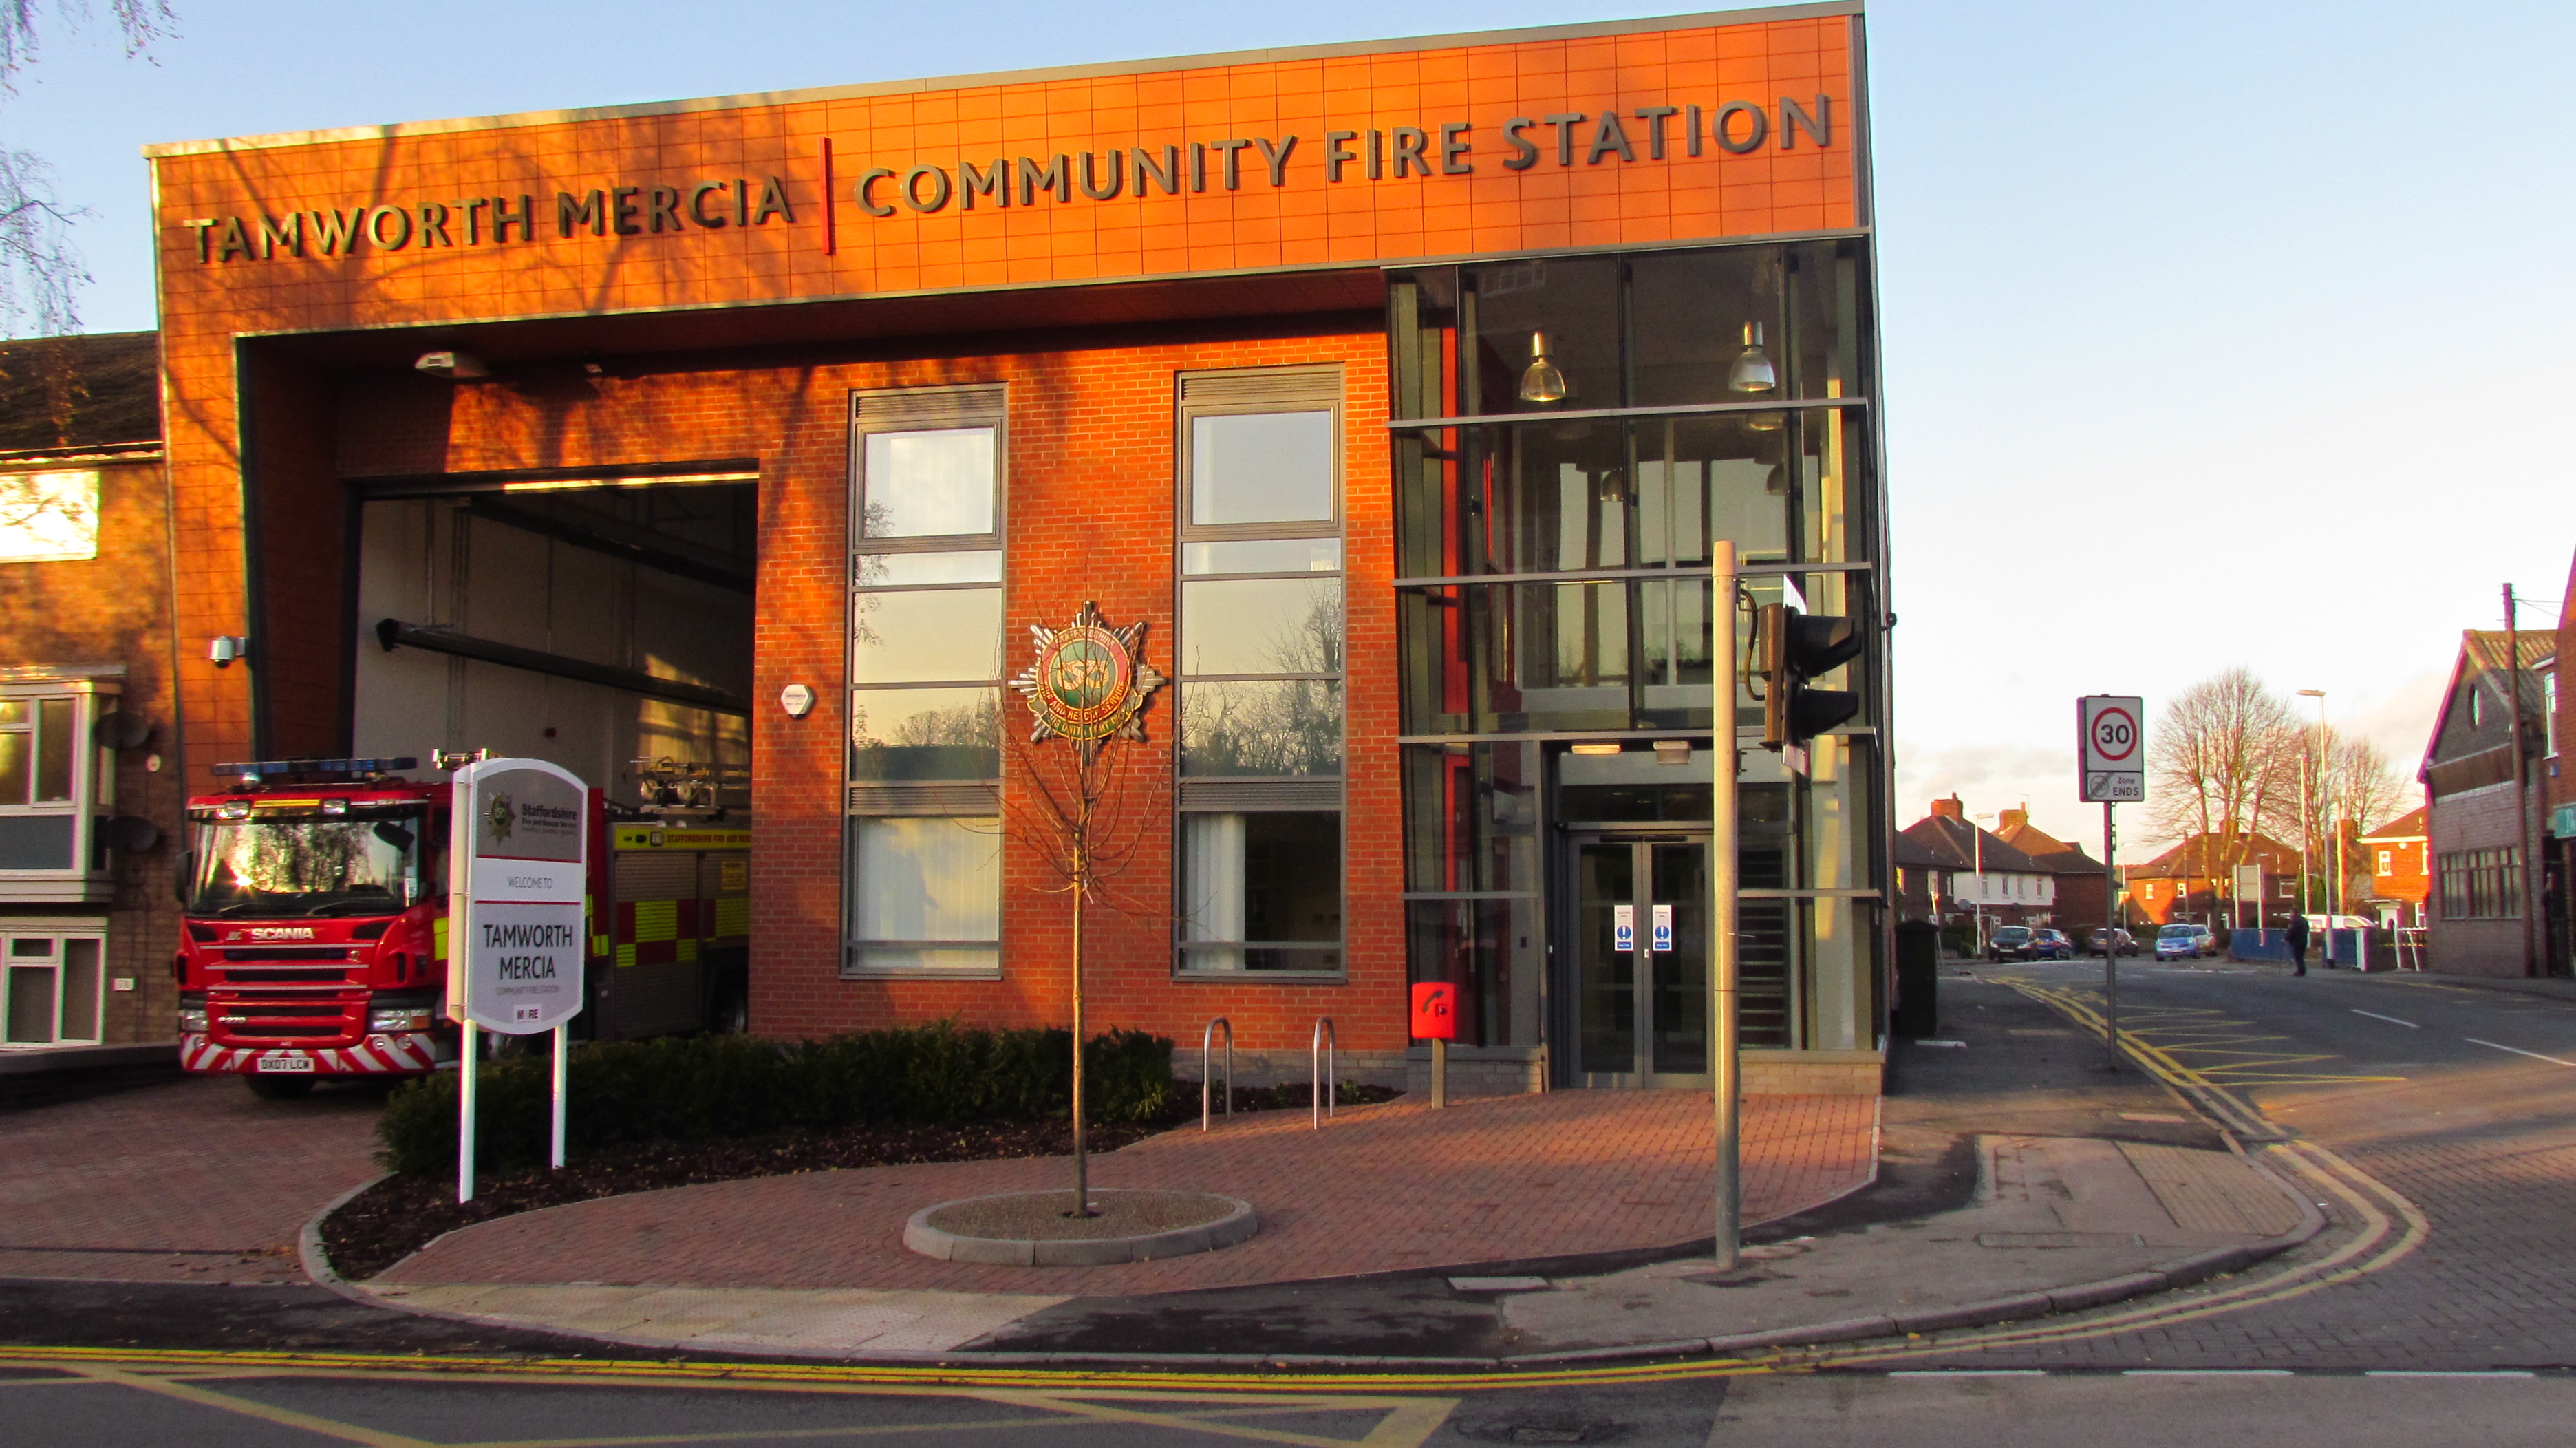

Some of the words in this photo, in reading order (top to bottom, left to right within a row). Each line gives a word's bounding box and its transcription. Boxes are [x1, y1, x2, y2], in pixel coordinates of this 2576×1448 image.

[853, 134, 1300, 217] COMMUNITY
[1326, 120, 1472, 183] FIRE
[1500, 92, 1831, 172] STATION
[184, 195, 531, 264] TAMWORTH
[557, 175, 795, 238] MERCIA
[2101, 725, 2129, 744] 30
[2117, 776, 2135, 785] Zone
[2112, 787, 2139, 796] ENDS
[522, 804, 577, 820] Staffordshire
[508, 877, 542, 888] WELCOME
[544, 877, 553, 888] TO
[251, 928, 314, 940] SCANIA
[483, 924, 572, 948] TAMWORTH
[500, 956, 556, 979] MERCIA
